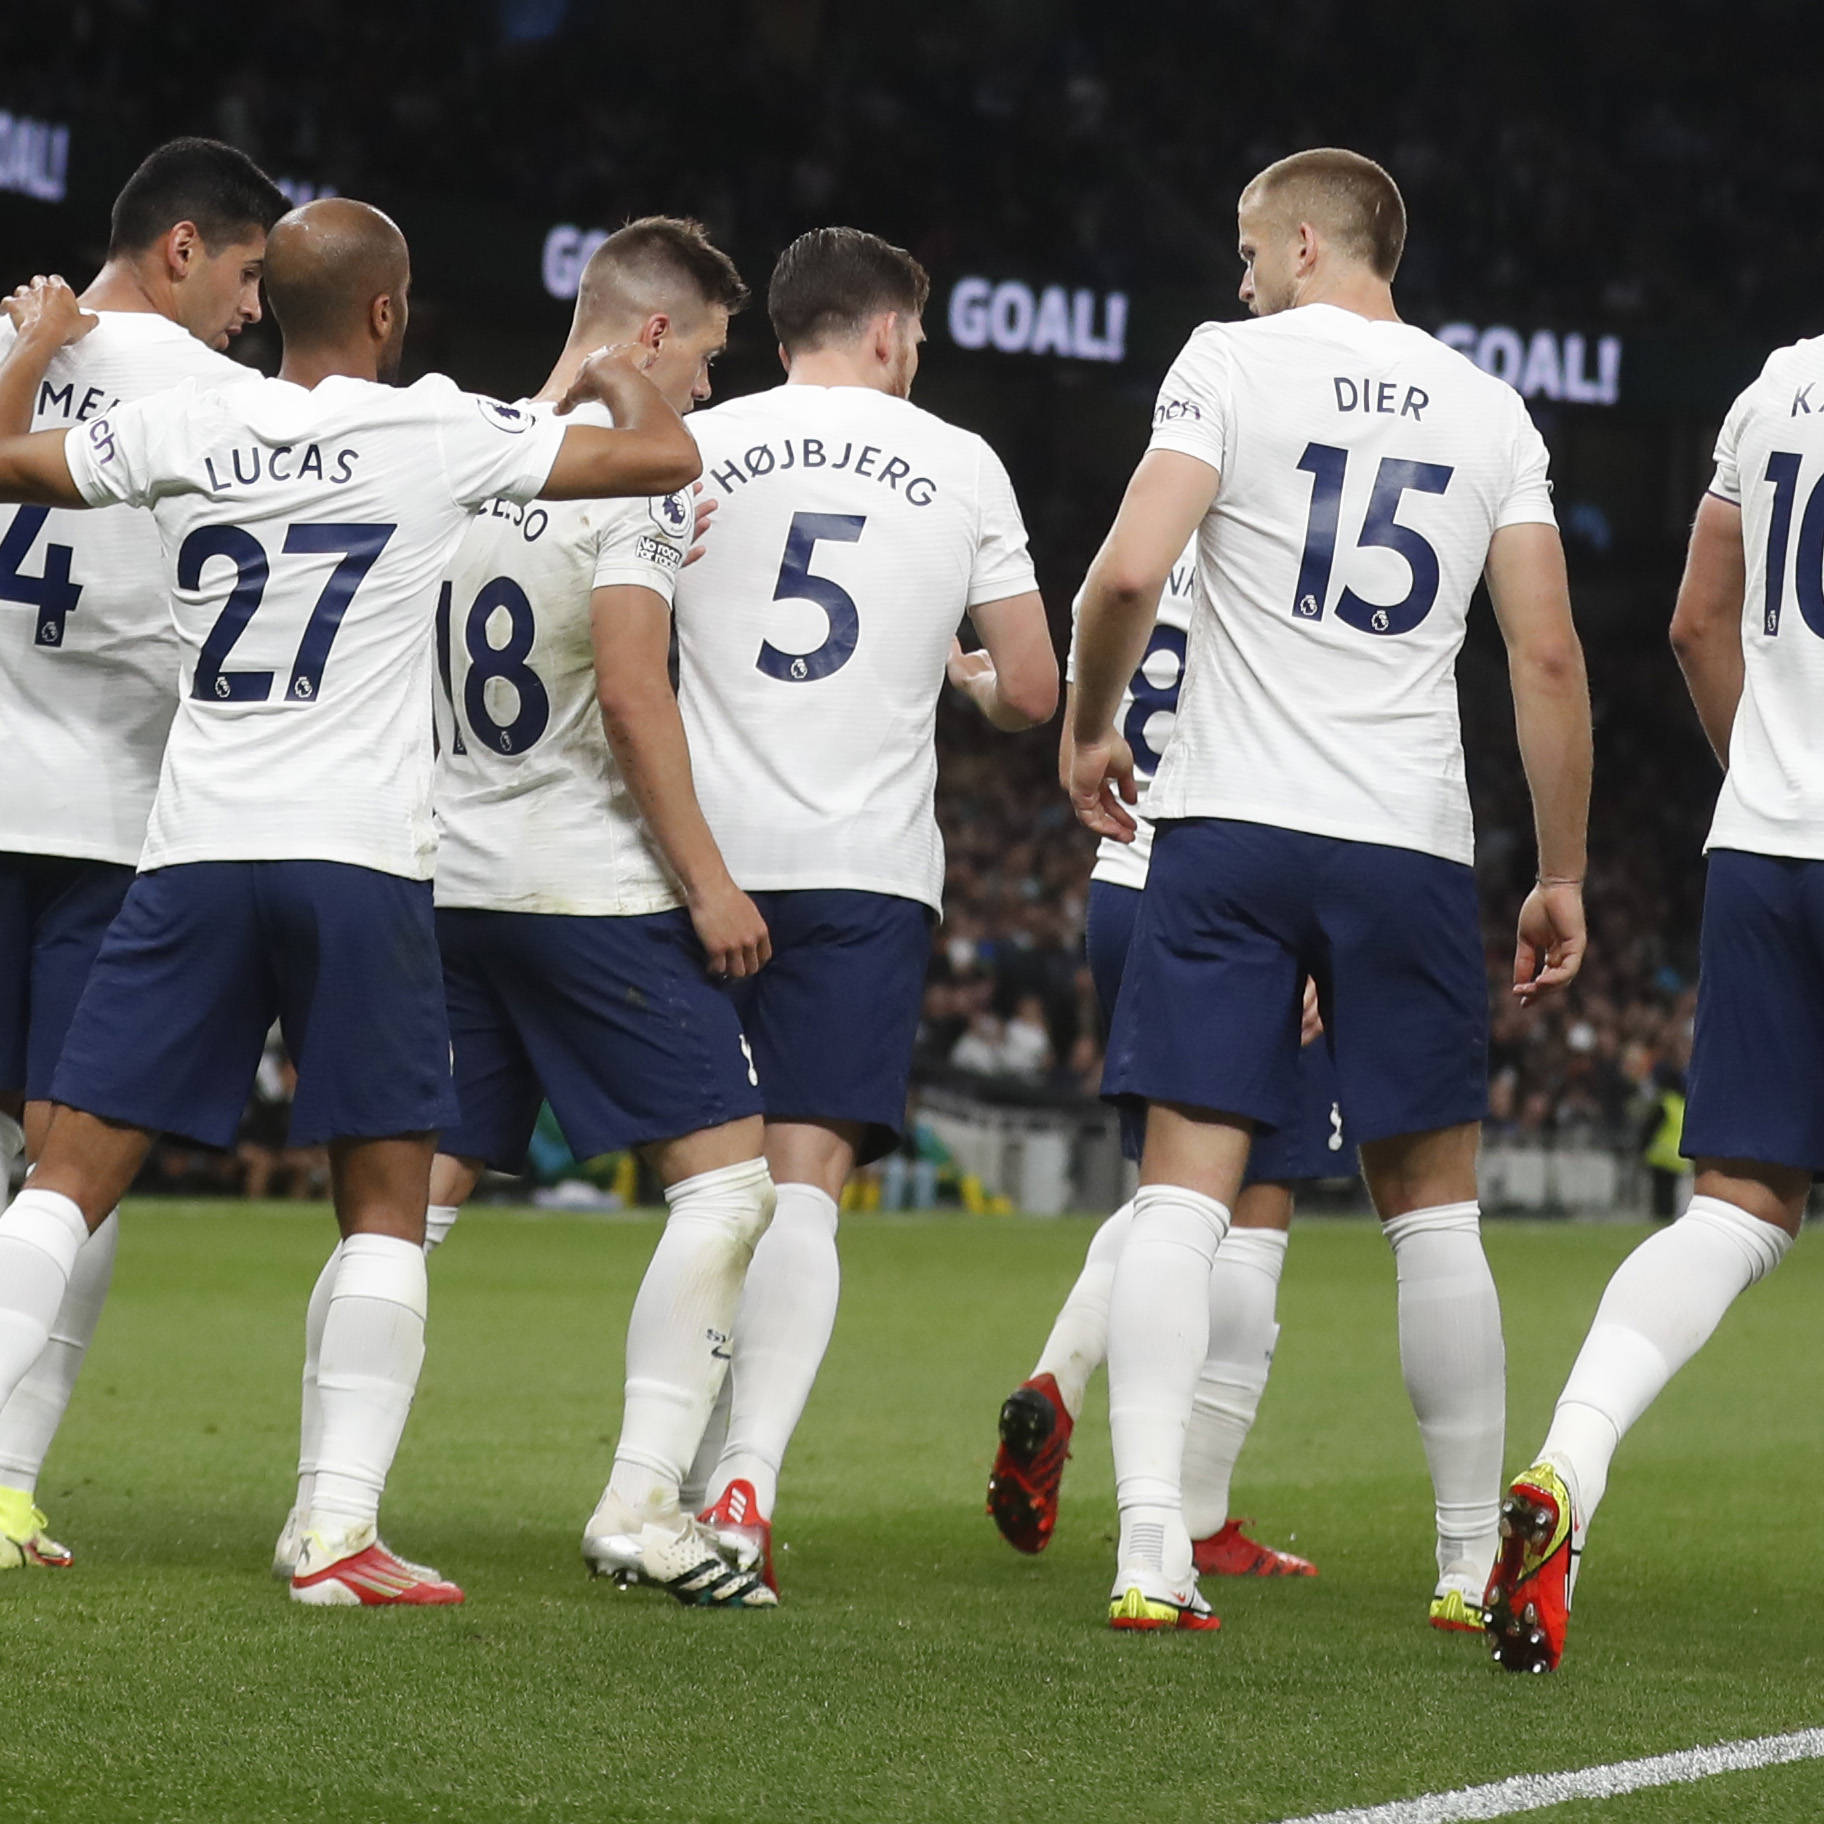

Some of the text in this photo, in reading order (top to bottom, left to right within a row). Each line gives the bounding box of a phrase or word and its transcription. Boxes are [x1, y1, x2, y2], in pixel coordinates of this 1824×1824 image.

[950, 278, 1126, 361] GOAL!
[1333, 376, 1429, 423] DIER
[204, 443, 360, 493] LUCAS
[711, 438, 938, 508] HØJBJERG
[756, 511, 867, 683] 5
[1293, 441, 1455, 636] 15
[177, 522, 398, 703] 27
[1123, 624, 1188, 777] 8
